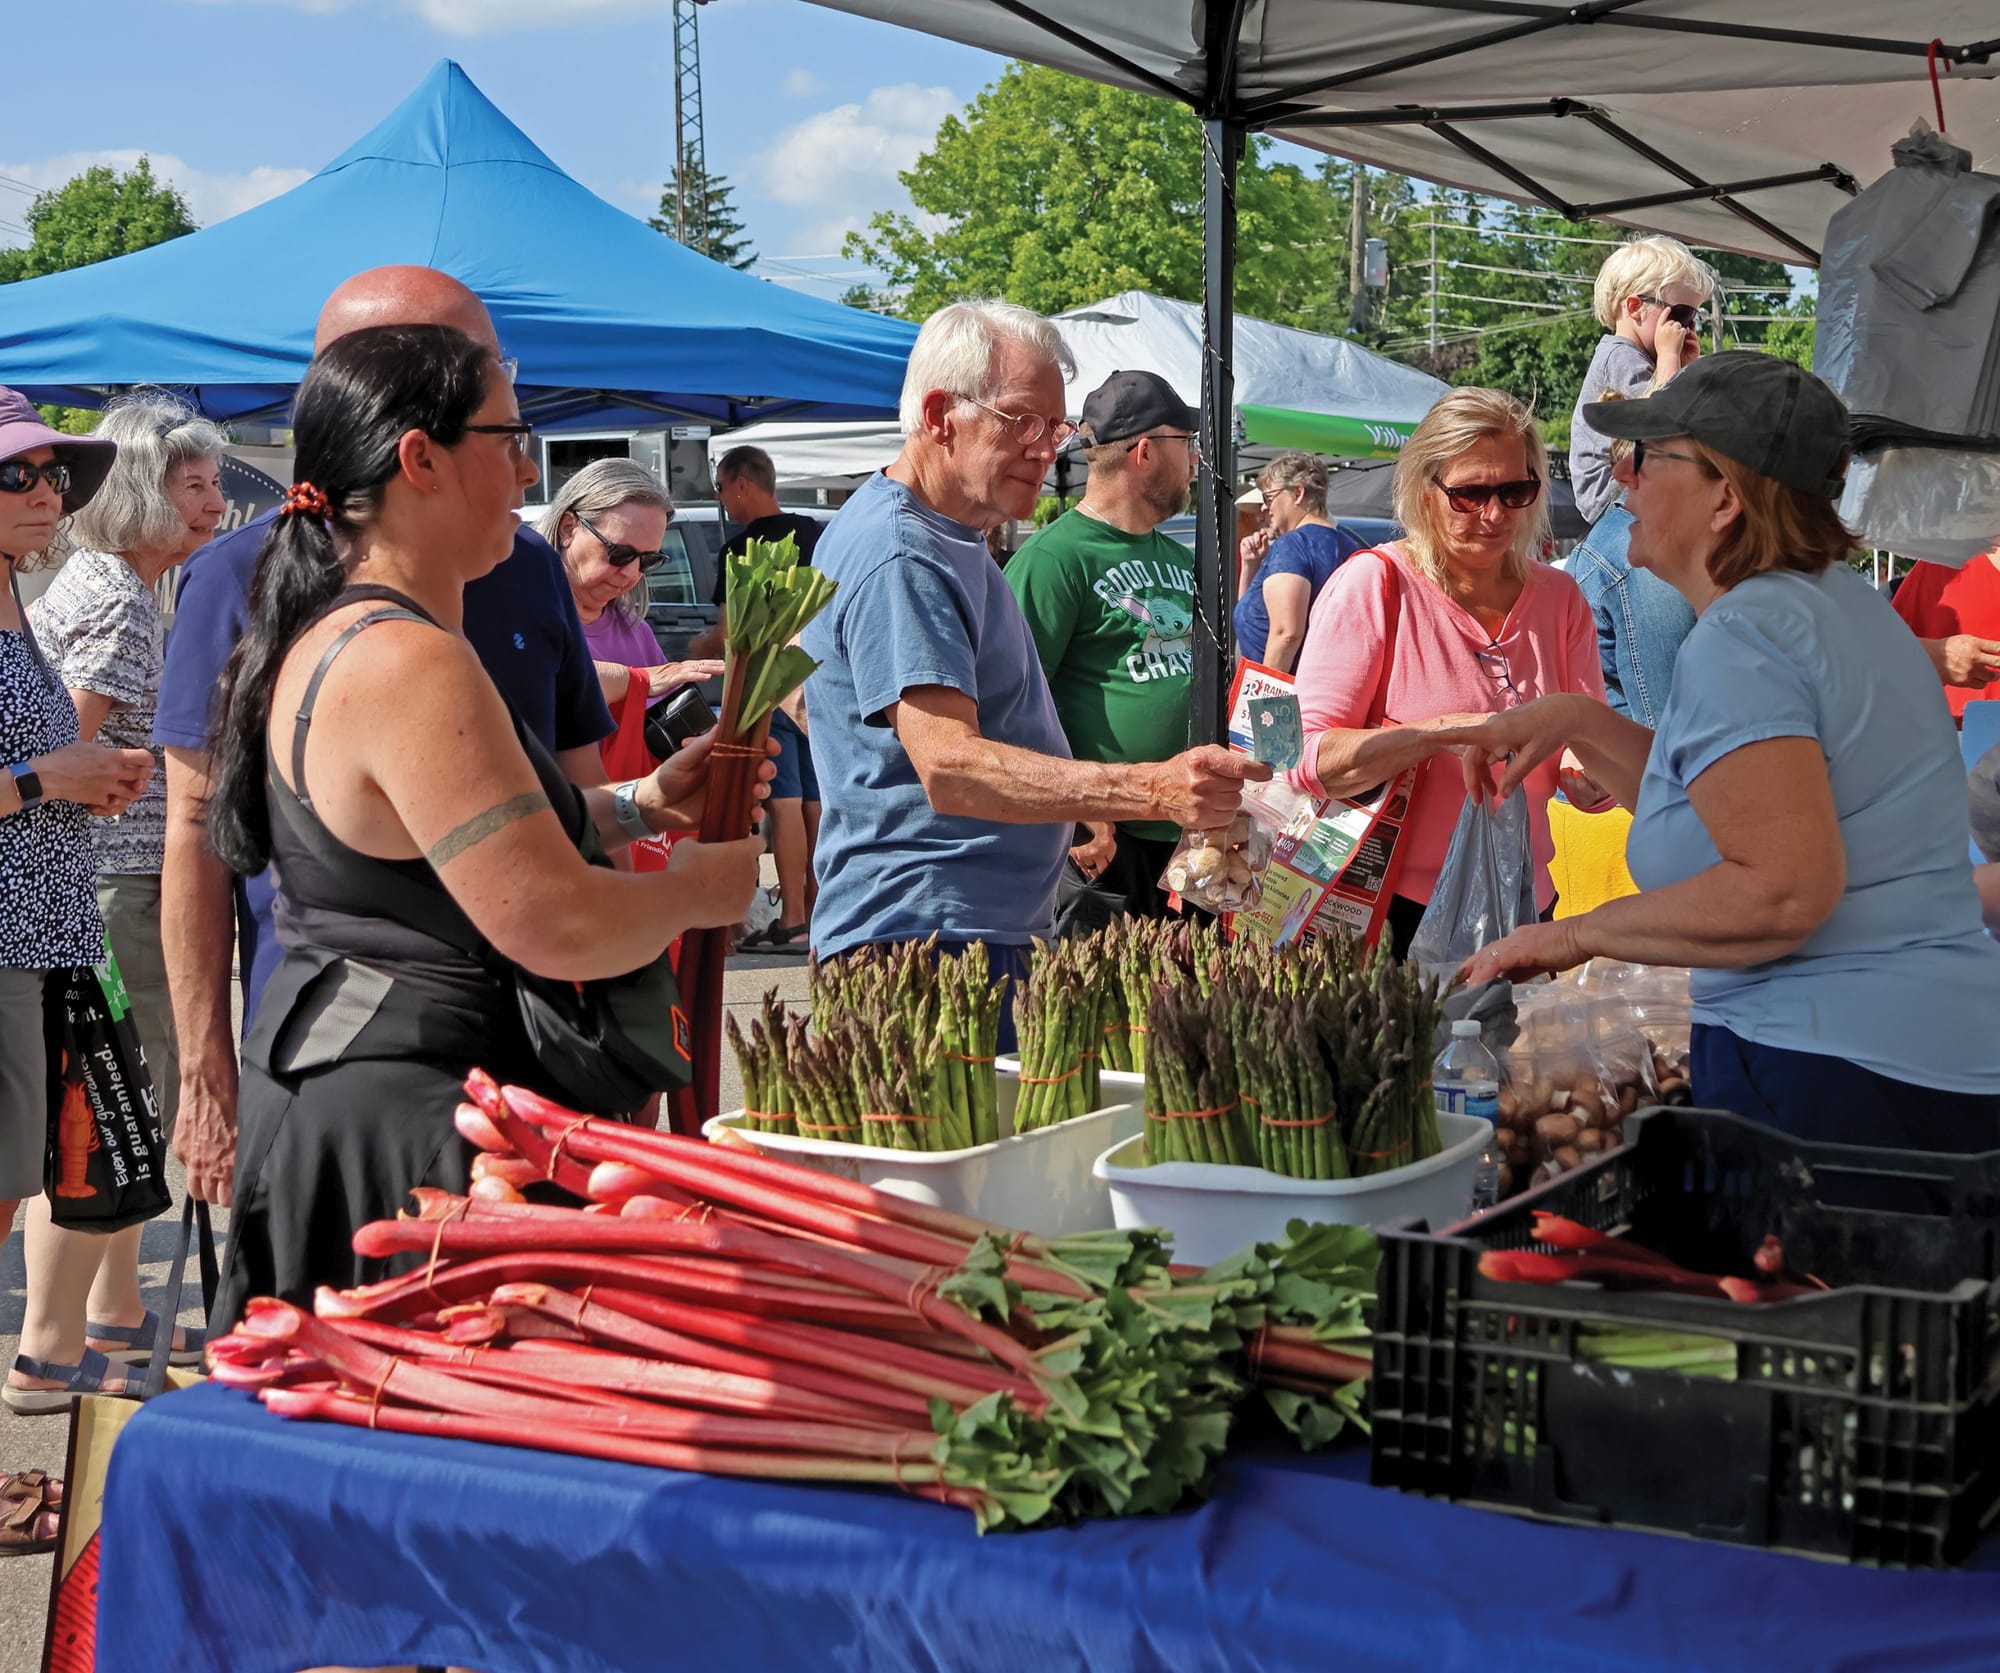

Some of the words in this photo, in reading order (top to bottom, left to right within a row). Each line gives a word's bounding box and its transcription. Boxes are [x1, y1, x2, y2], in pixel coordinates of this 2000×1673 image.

[1093, 560, 1155, 608] GOOD
[95, 1042, 149, 1157] guaranteed.
[100, 1124, 117, 1148] our
[110, 1150, 129, 1188] Even
[135, 1164, 151, 1186] is
